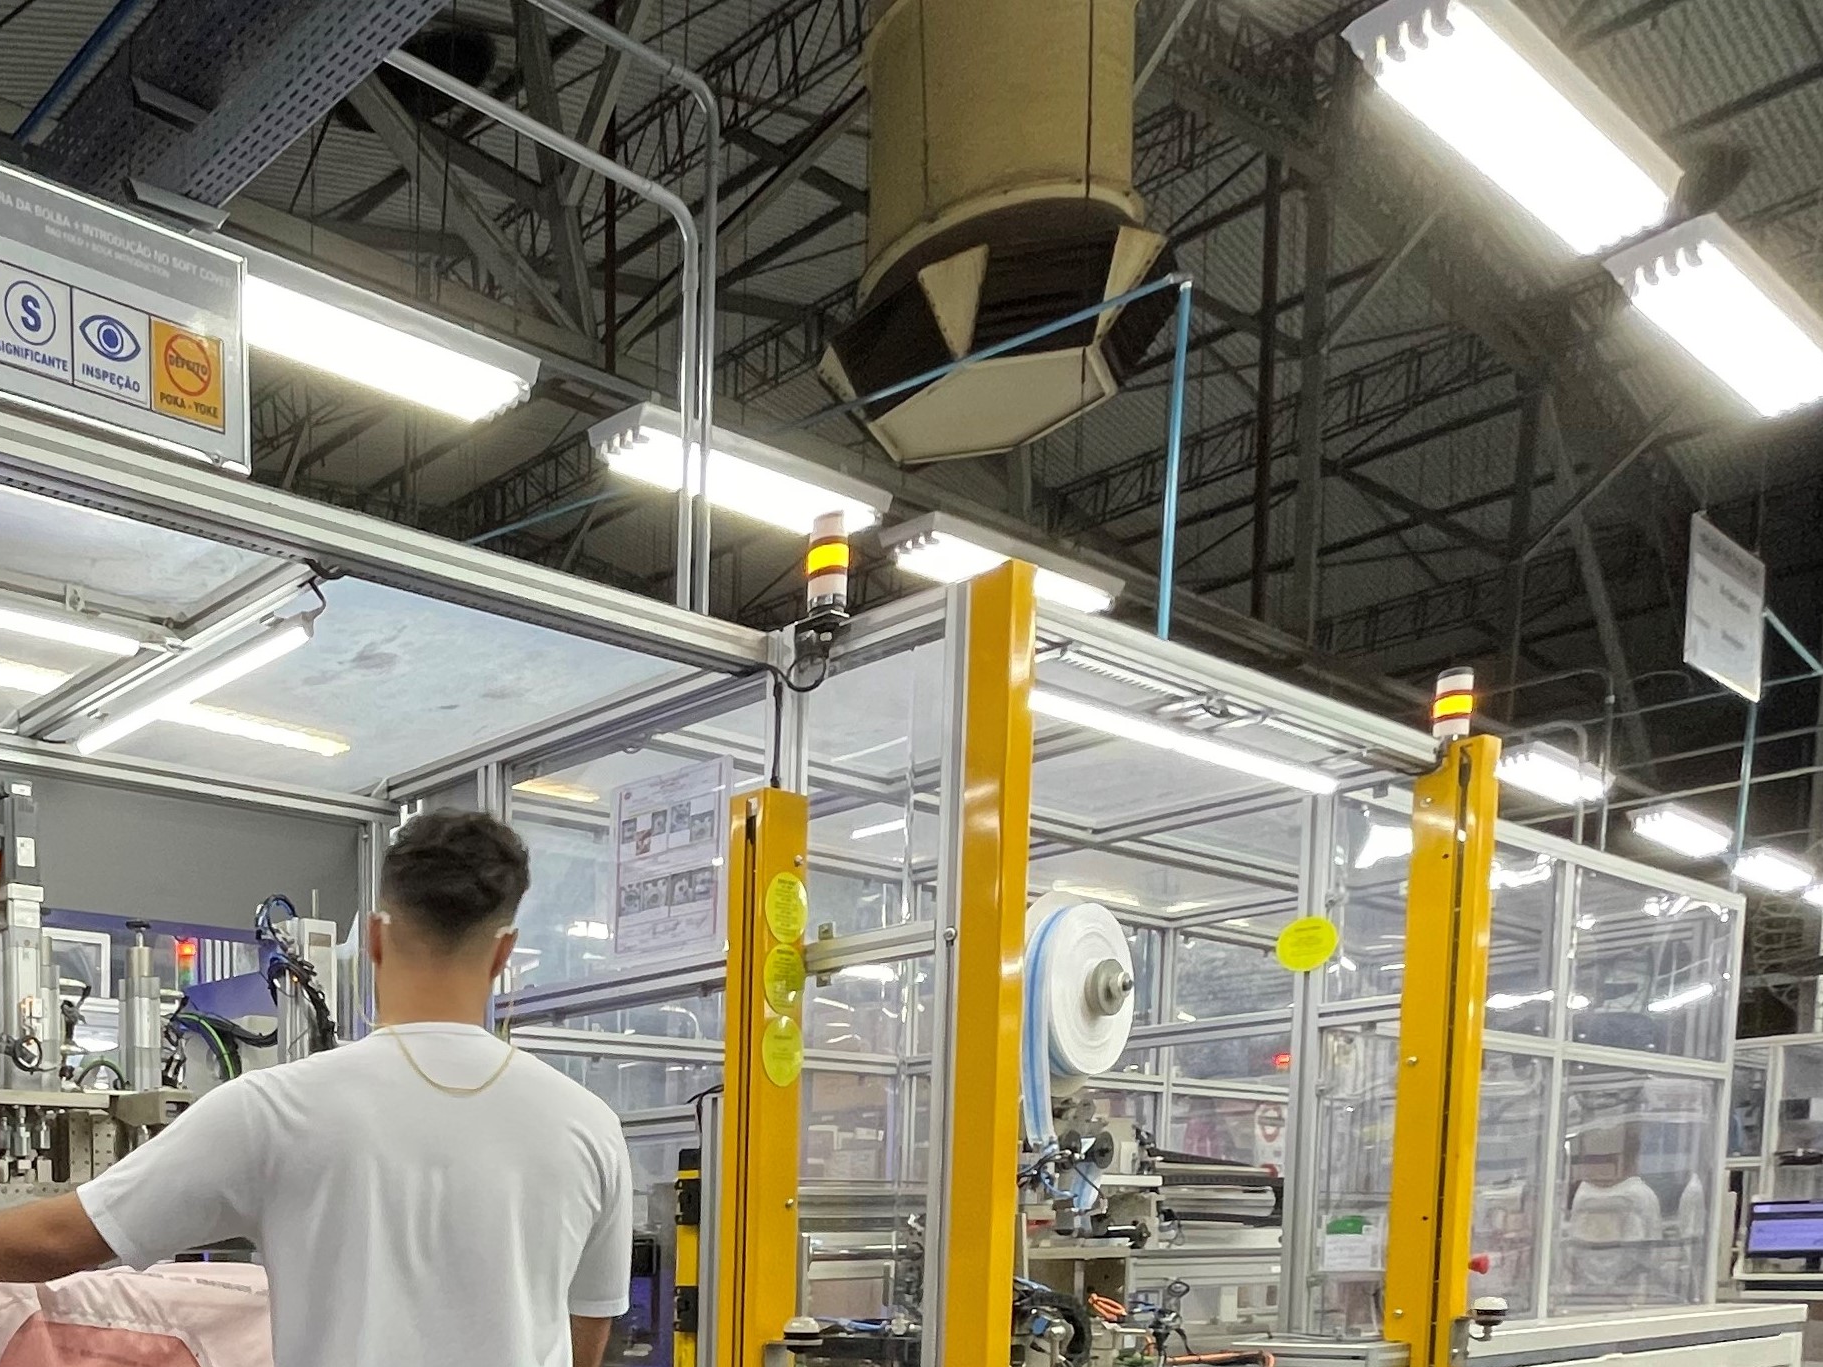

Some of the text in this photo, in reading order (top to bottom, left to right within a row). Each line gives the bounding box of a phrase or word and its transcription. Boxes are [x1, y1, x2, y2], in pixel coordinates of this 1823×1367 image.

[15, 199, 32, 213] DA
[154, 249, 170, 266] NO
[172, 255, 197, 275] SOFT
[21, 295, 41, 332] S
[82, 363, 140, 393] INSPEÇÃO
[160, 391, 186, 409] POKA
[194, 401, 218, 419] YOKE
